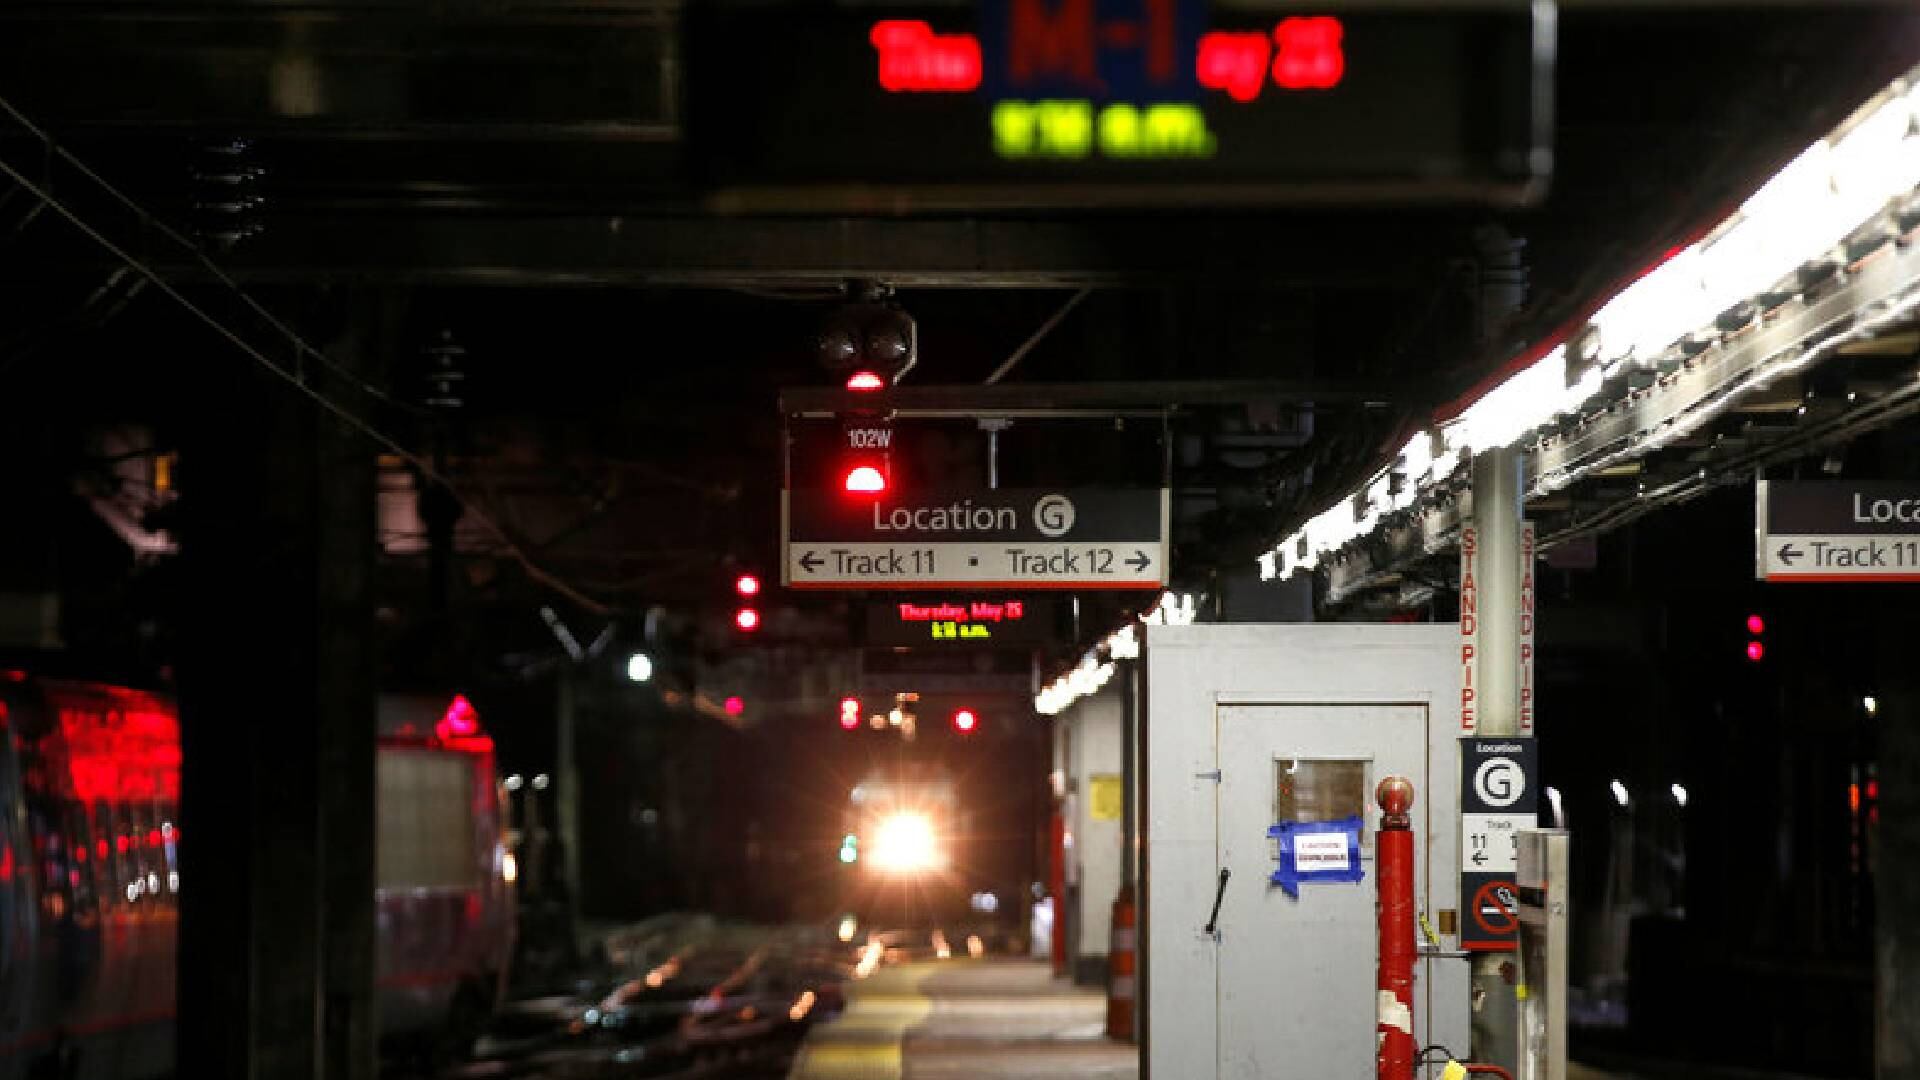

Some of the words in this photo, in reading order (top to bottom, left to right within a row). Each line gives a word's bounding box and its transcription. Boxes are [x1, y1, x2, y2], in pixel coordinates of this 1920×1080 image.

[847, 428, 892, 449] 102W
[873, 499, 1017, 531] Location
[831, 549, 906, 575] Track
[911, 550, 936, 575] 11
[1006, 549, 1080, 575] Track
[1086, 550, 1114, 575] 12
[1810, 541, 1887, 567] Track
[1892, 542, 1918, 567] 11
[1461, 528, 1476, 636] STAND
[1520, 528, 1533, 636] STAND
[1461, 643, 1474, 730] PIPE
[1520, 643, 1532, 730] PIPE
[1476, 742, 1523, 753] Location
[1470, 833, 1487, 849] 11
